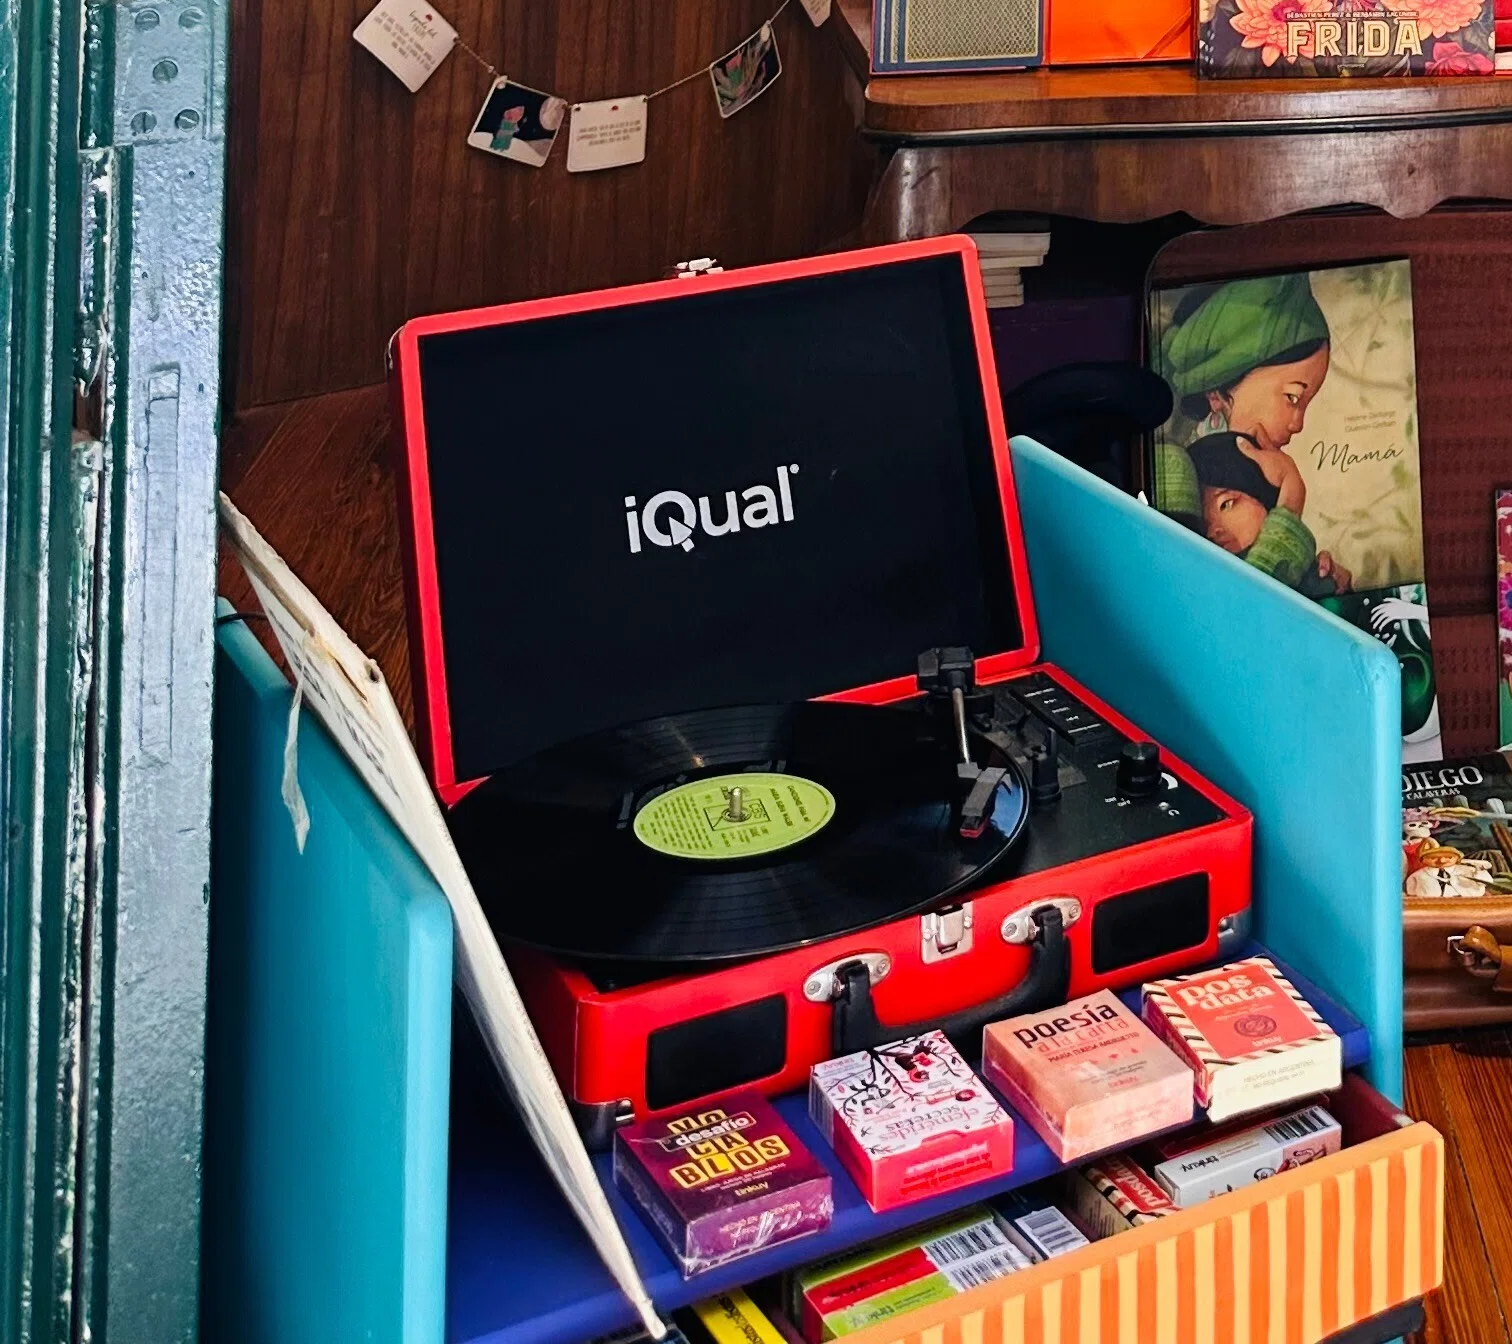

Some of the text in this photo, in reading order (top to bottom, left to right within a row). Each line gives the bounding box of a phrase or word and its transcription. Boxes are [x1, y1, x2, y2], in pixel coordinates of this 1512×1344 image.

[1286, 18, 1424, 58] FRIDA
[1309, 440, 1404, 473] Mamá
[625, 465, 795, 554] iQual
[1177, 973, 1254, 1007] pos
[1200, 985, 1276, 1011] data
[1013, 1003, 1118, 1049] poesía
[1076, 1017, 1130, 1042] carta
[675, 1115, 751, 1147] desafío
[675, 1137, 788, 1184] BLOS
